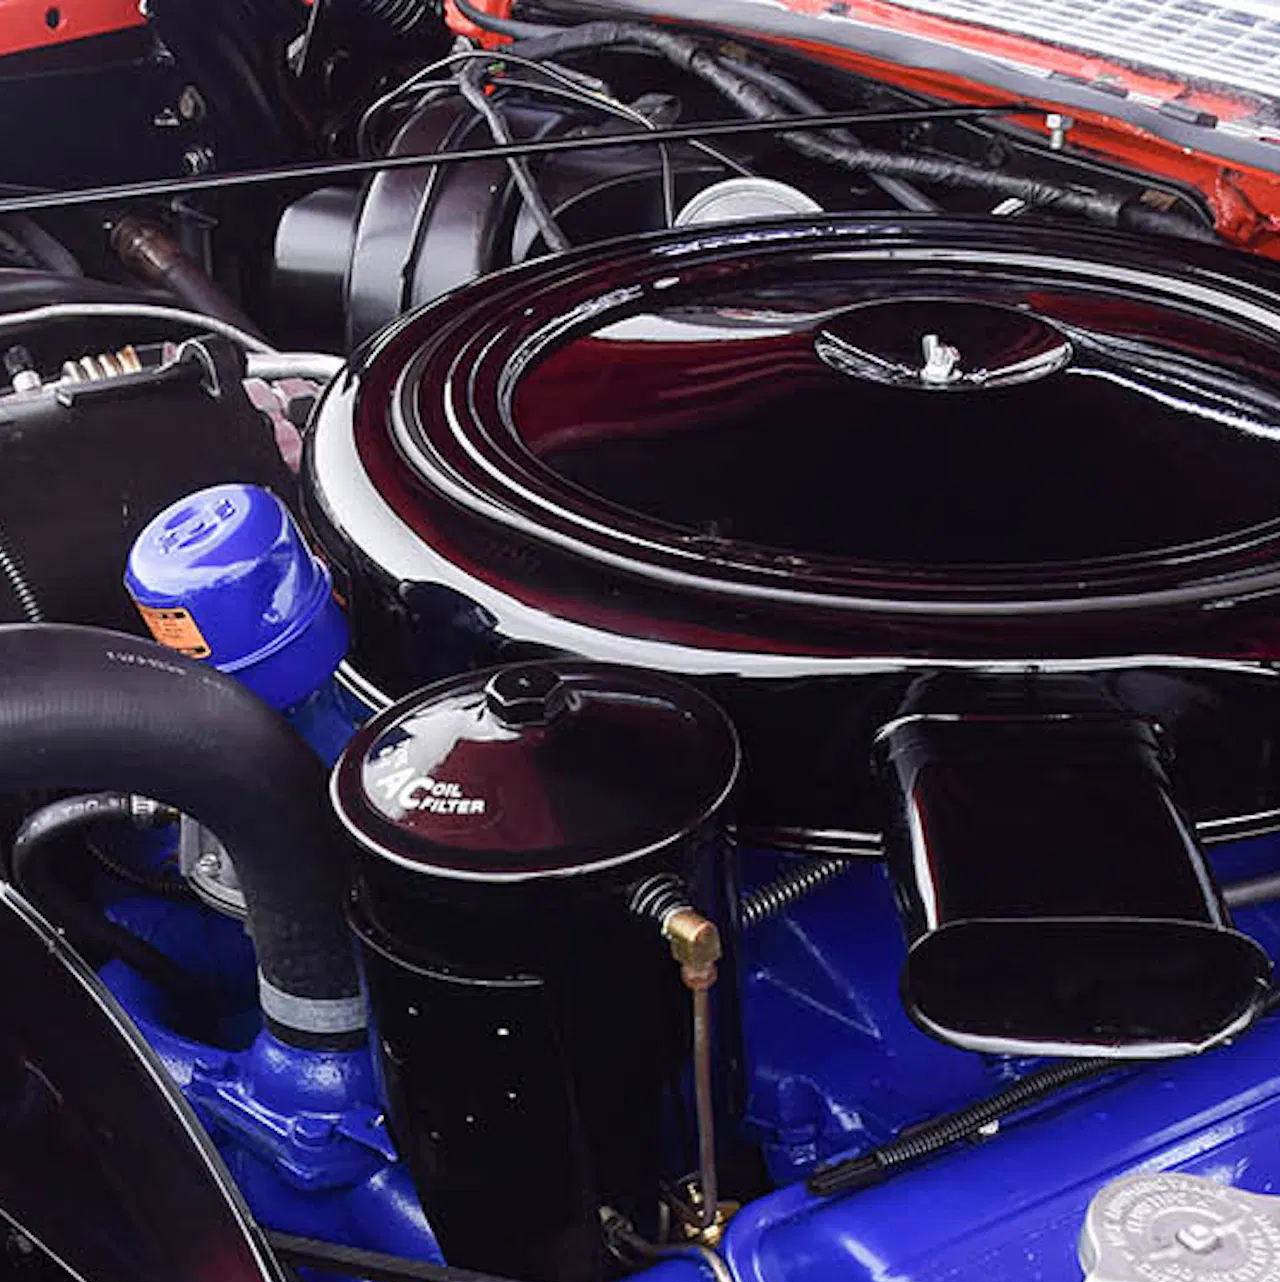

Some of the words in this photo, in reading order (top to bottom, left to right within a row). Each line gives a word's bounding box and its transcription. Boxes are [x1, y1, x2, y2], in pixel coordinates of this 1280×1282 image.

[375, 767, 434, 808] AC
[433, 783, 462, 798] OIL
[419, 798, 485, 814] FILTER
